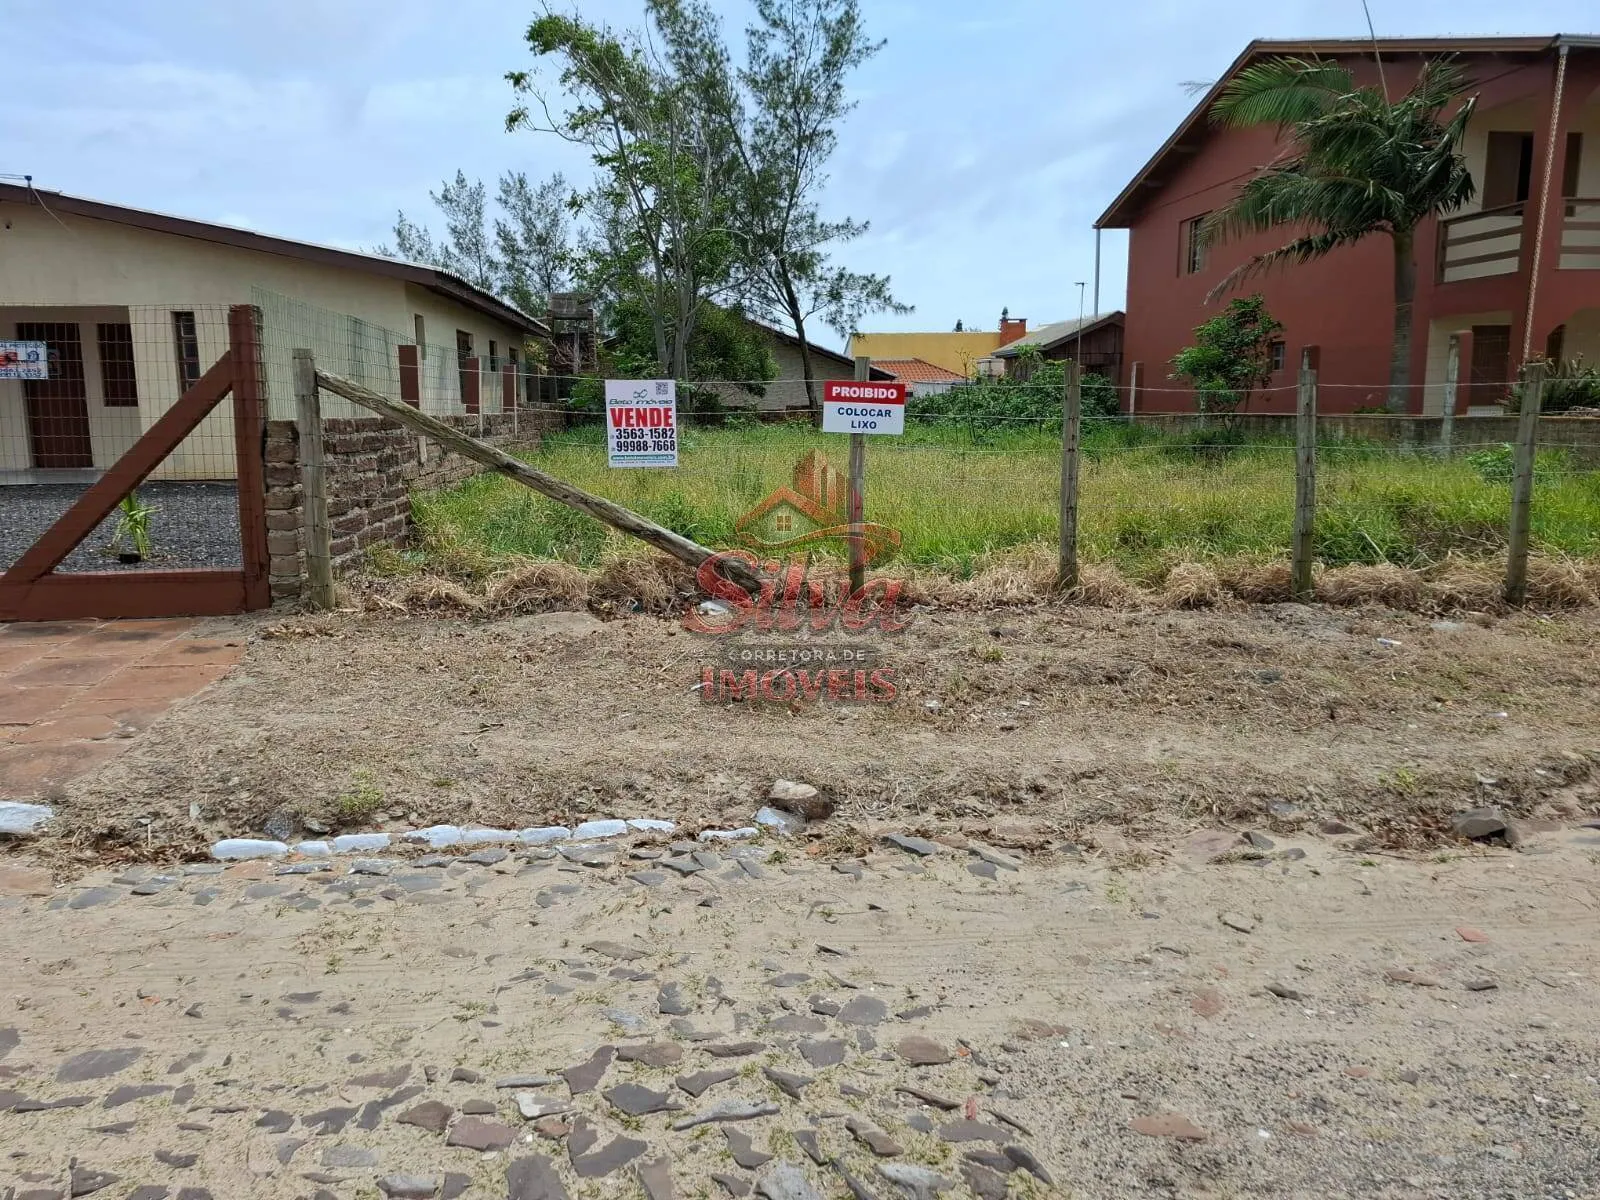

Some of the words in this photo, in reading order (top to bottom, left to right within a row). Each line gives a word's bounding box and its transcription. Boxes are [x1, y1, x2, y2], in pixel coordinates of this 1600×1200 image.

[832, 386, 898, 399] PROIBIDO
[609, 407, 673, 428] VENDE
[837, 407, 892, 418] COLOCAR
[851, 420, 877, 430] LIXO
[615, 428, 675, 440] 3563-1582
[616, 440, 676, 452] 99988-7668
